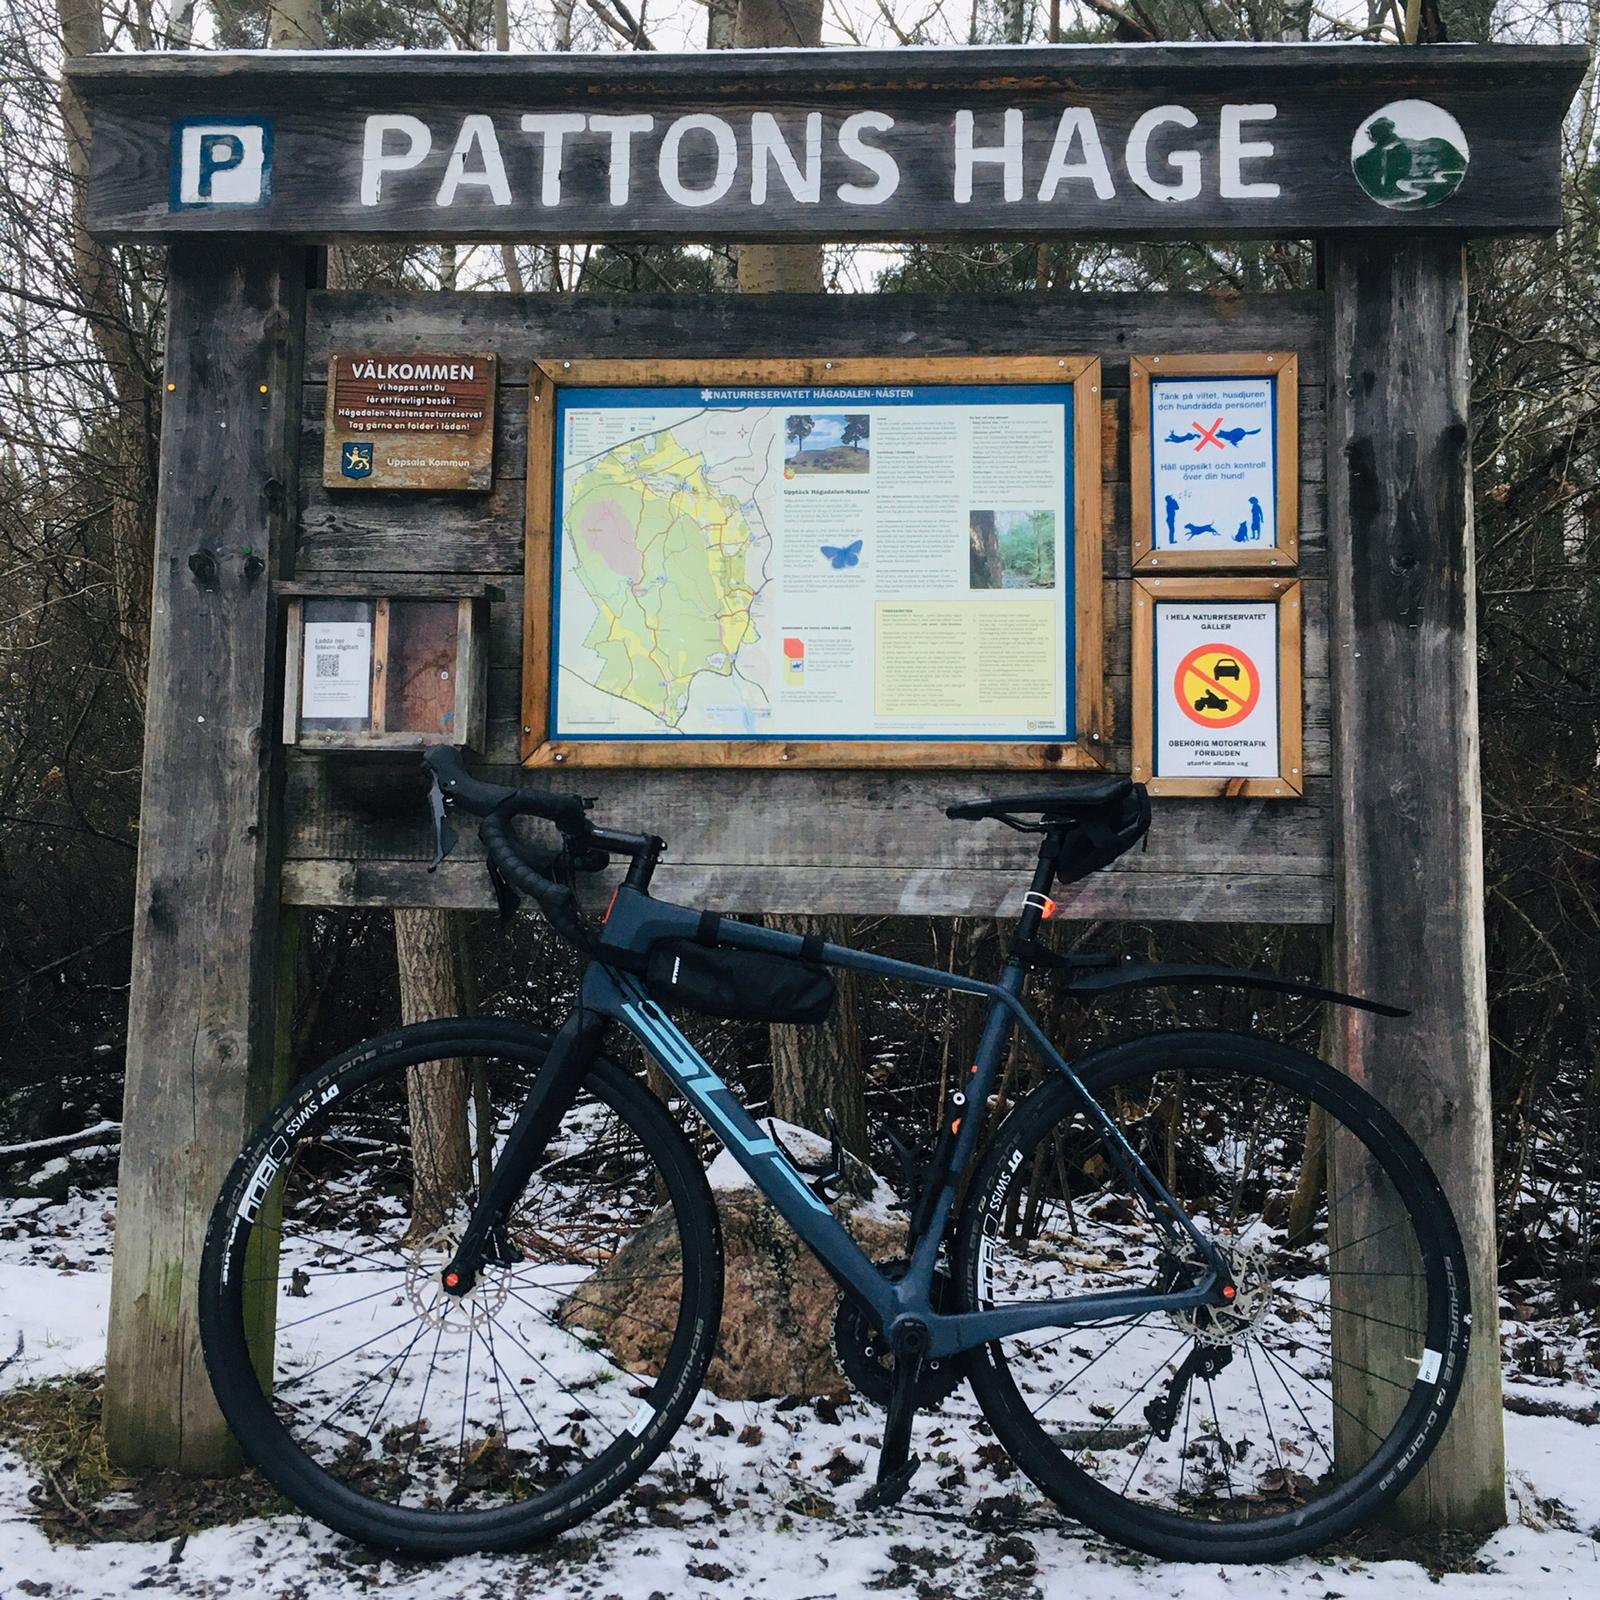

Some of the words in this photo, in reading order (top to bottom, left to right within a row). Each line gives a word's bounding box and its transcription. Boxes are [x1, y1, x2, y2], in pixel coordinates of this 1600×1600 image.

[360, 111, 900, 206] PATTONS
[953, 103, 1281, 204] HAGE
[198, 134, 245, 197] P
[351, 359, 475, 381] VÄLKOMMEN
[377, 383, 387, 392] Vi
[387, 383, 419, 393] hoppas
[419, 384, 433, 392] att
[434, 384, 446, 392] Du
[366, 395, 379, 404] får
[379, 396, 392, 404] ett
[393, 396, 425, 406] trevligt
[426, 396, 451, 405] besök
[712, 390, 810, 400] NATURRESERVATET
[1159, 391, 1180, 401] Tänk
[1182, 391, 1194, 402] på
[1222, 390, 1266, 401] husdjuren
[1157, 402, 1175, 411] och
[1176, 401, 1222, 411] hundrädda
[1225, 400, 1267, 412] personer!
[424, 410, 483, 419] naturreservat
[348, 421, 364, 431] Tag
[365, 421, 393, 432] gärna
[407, 422, 434, 431] folder
[441, 421, 470, 432] lådan!
[386, 457, 426, 468] Uppsala
[428, 459, 470, 468] Kommun
[1160, 462, 1177, 471] Håll
[1179, 462, 1212, 473] uppsikt
[1214, 462, 1231, 470] och
[1233, 461, 1267, 470] kontroll
[1183, 473, 1202, 481] över
[1204, 472, 1218, 480] din
[1220, 471, 1245, 480] hund!
[1170, 613, 1191, 621] HELA
[1192, 613, 1267, 622] NATURRESERVATET
[1200, 623, 1232, 631] GÄLLER
[314, 637, 334, 645] Ladda
[1168, 738, 1210, 748] OBEHÖRIG
[1210, 739, 1267, 748] MOTORTRAFIK
[1194, 748, 1241, 757] FÖRBJUDEN
[1186, 759, 1212, 767] utanför
[320, 1084, 341, 1105] DT
[285, 1101, 320, 1138] SWISS
[1007, 1148, 1025, 1174] DT
[989, 1171, 1012, 1213] SWISS
[1443, 1255, 1462, 1384] SCHWALBE
[647, 1318, 705, 1441] SCHWALBE
[1396, 1410, 1439, 1472] G-ONE
[568, 1460, 629, 1510] G-ONE
